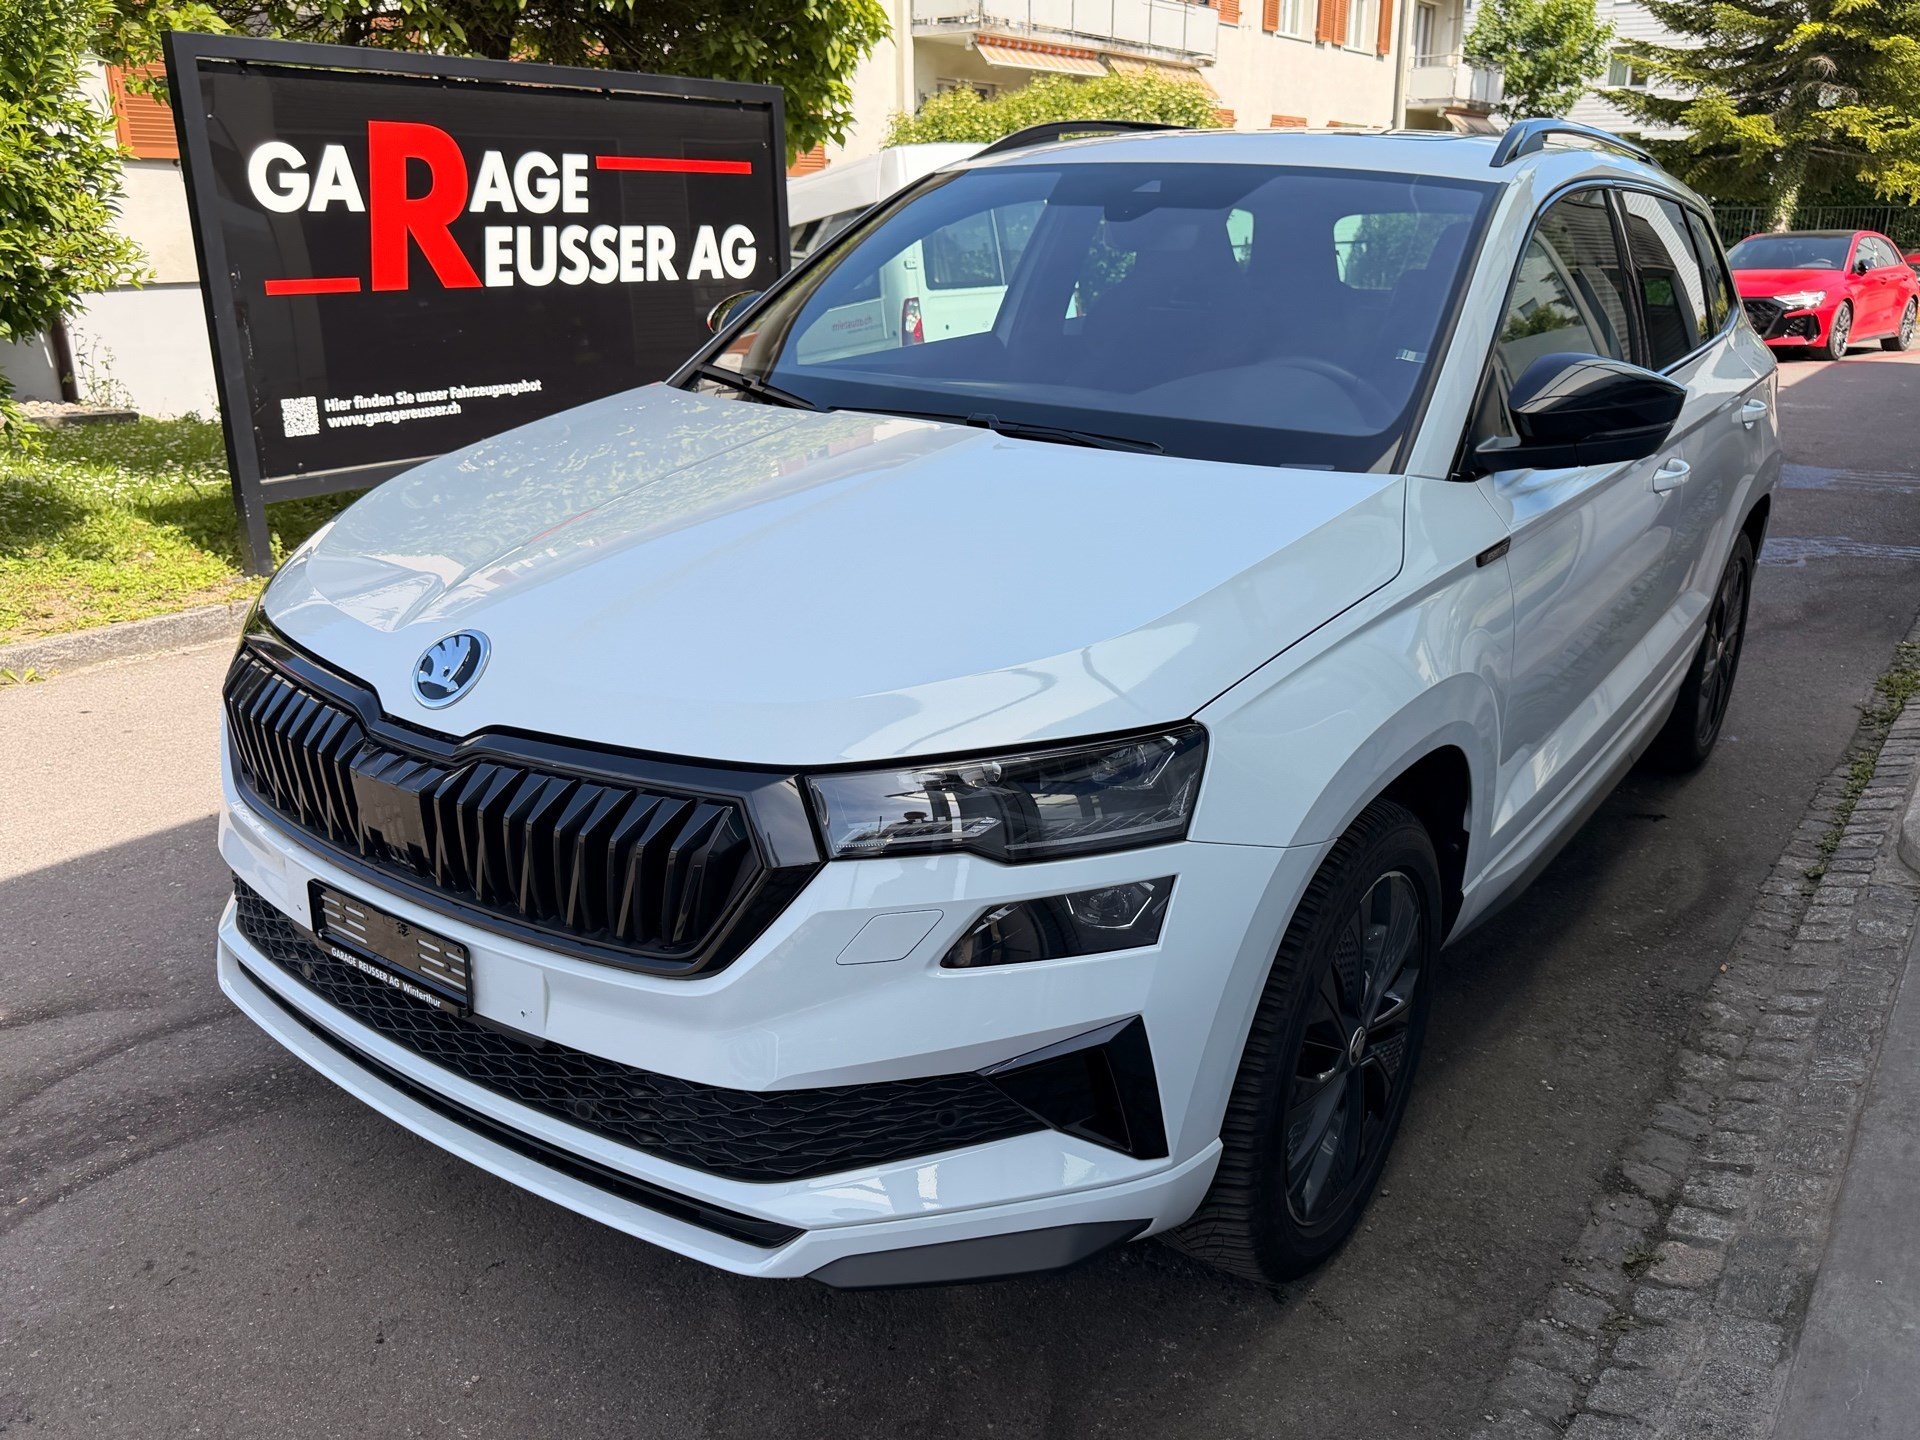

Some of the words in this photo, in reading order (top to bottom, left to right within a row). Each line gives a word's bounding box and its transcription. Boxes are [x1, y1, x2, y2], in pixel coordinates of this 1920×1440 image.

[248, 120, 590, 292] GARAGE
[686, 224, 757, 280] AG
[324, 397, 352, 412] Hier
[353, 394, 394, 409] finden
[395, 391, 414, 404] Sie
[416, 389, 448, 402] unser
[449, 379, 542, 399] Fahrzeugangebot
[327, 401, 461, 428] www.garagereusser.ch
[331, 947, 357, 967] GARAGE
[358, 960, 388, 983] REUSSER
[389, 976, 400, 988] AG
[402, 982, 441, 1008] Winterthur
